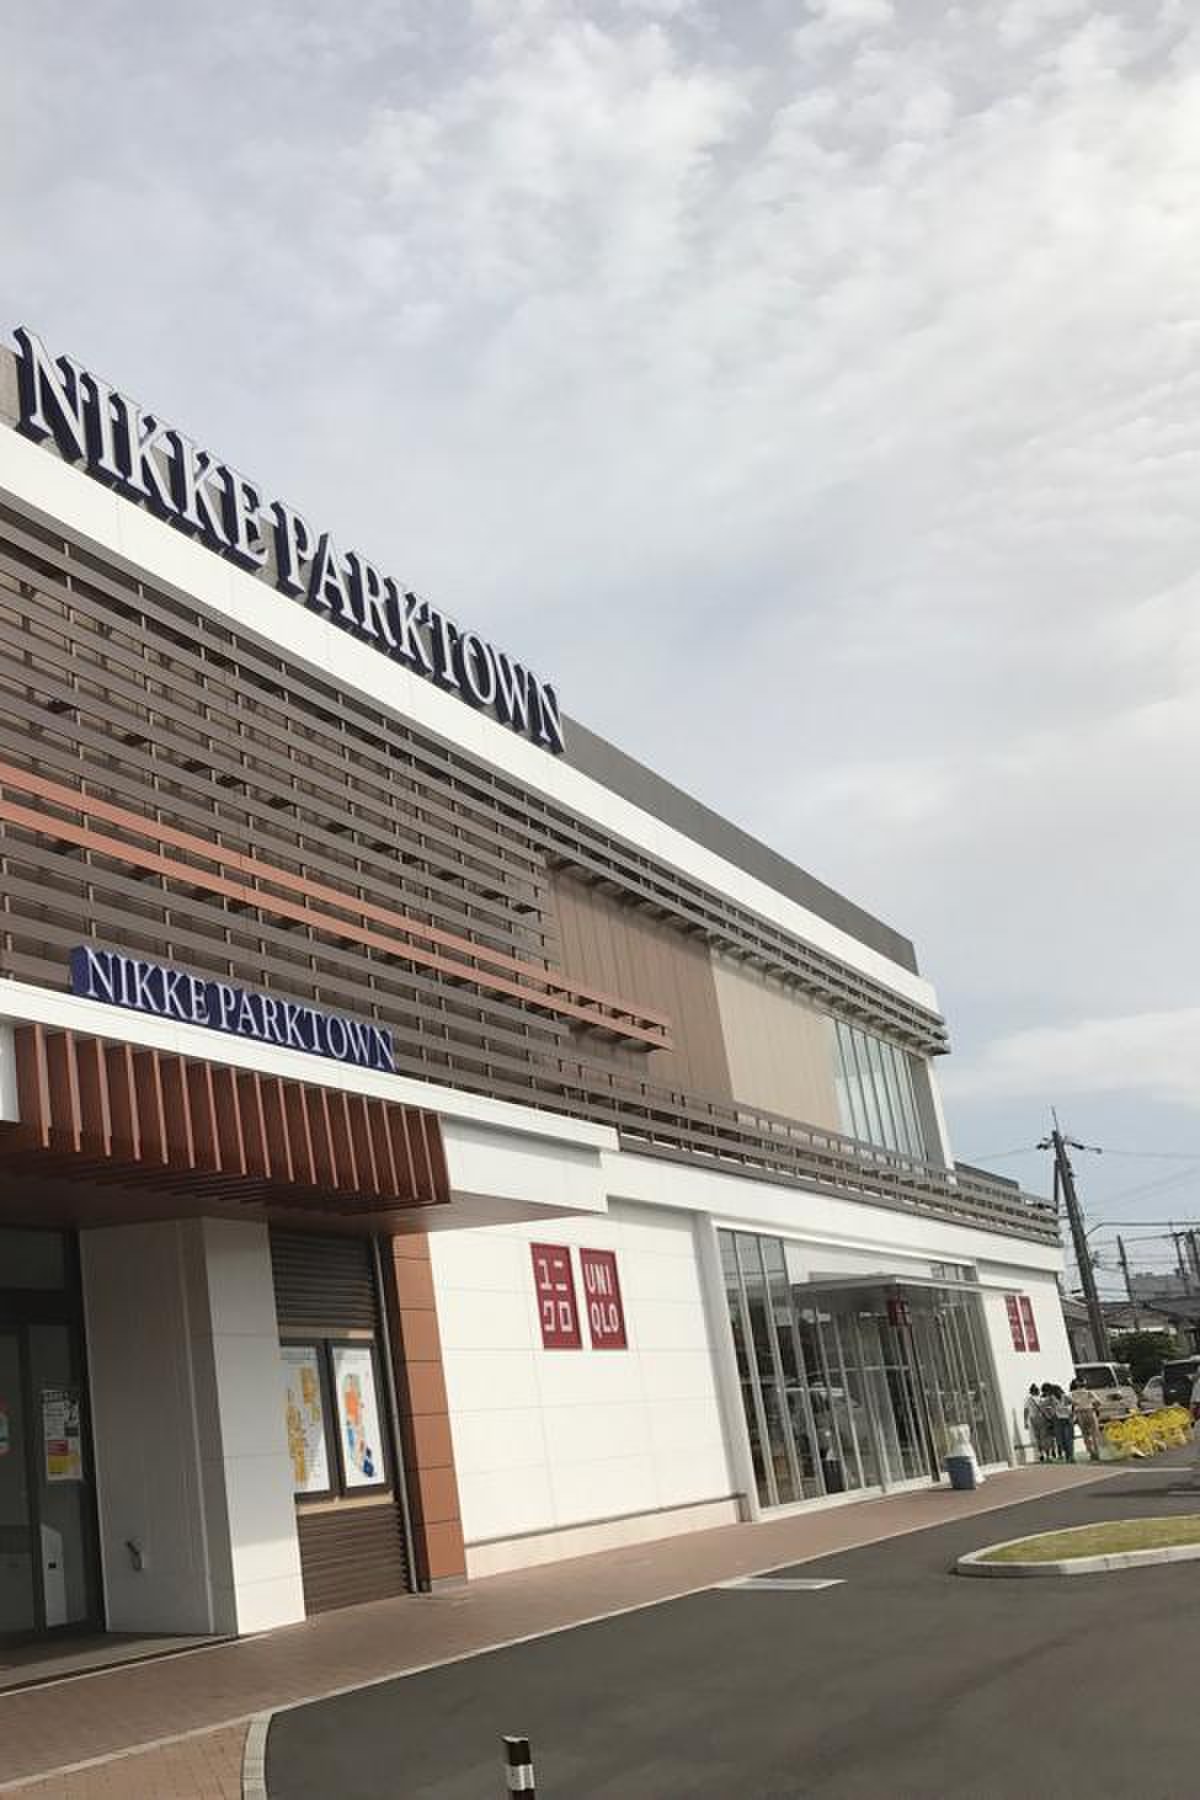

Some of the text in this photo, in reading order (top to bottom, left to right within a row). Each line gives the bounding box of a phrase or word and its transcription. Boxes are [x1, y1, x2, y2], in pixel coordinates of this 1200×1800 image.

[13, 324, 566, 753] NIKKE PARKTOWN
[83, 945, 399, 1072] NIKKE PARKTOWN
[584, 1263, 613, 1296] UNI
[591, 1301, 621, 1338] QLO
